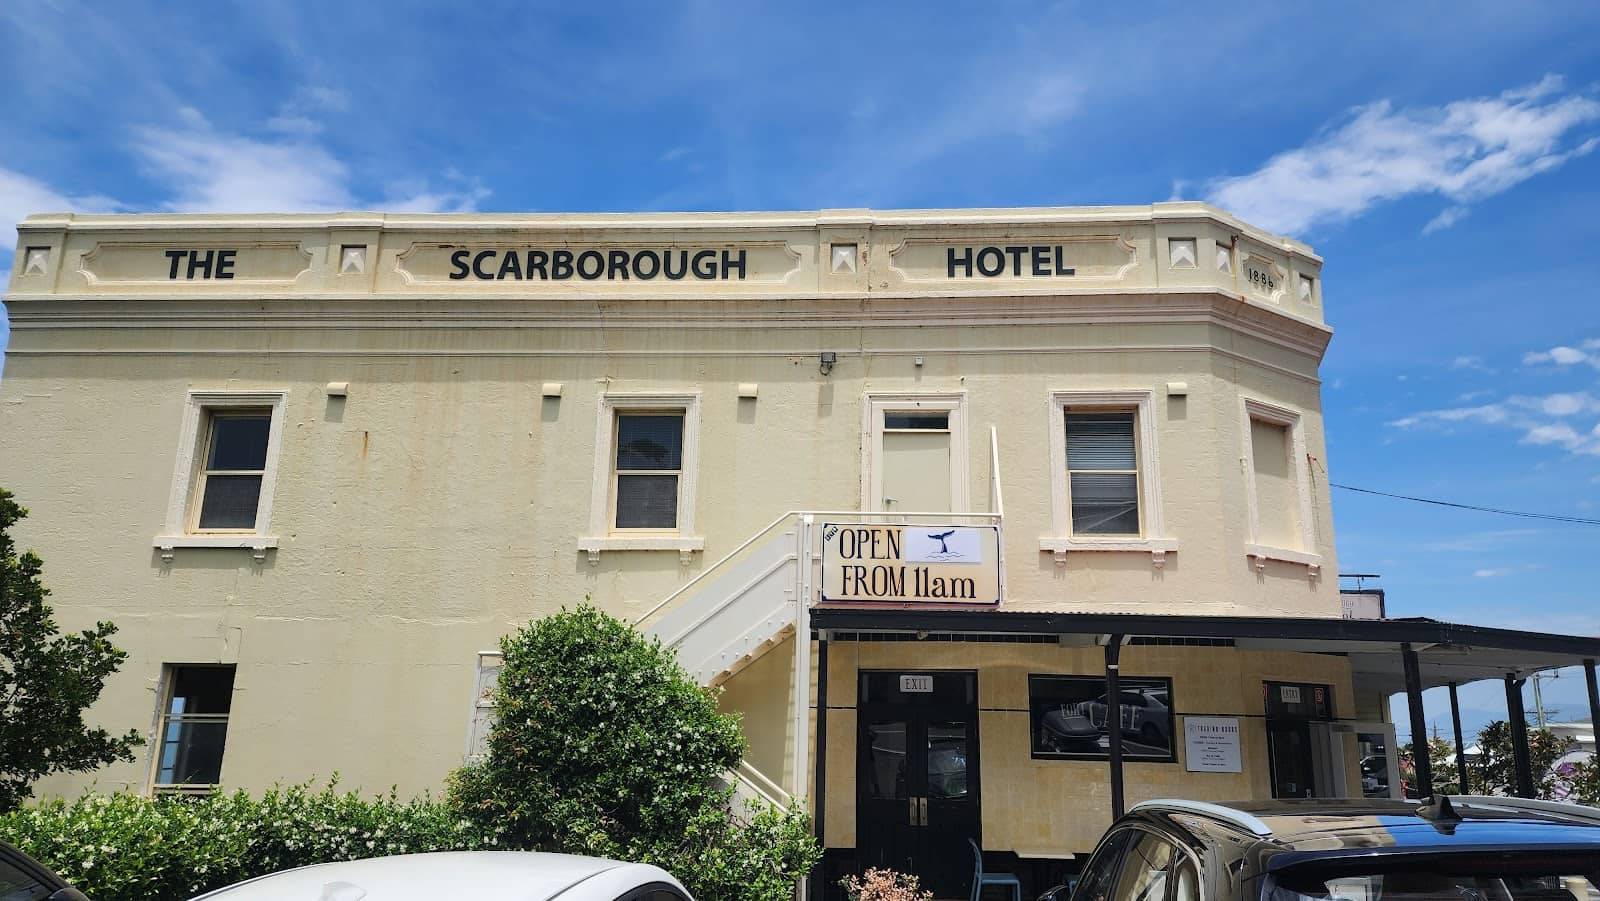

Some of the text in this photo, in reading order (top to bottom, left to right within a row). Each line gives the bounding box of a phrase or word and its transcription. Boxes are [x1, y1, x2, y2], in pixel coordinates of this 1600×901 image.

[165, 246, 1075, 281] THE SCARBOROUGH HOTEL
[1248, 267, 1274, 288] 1886
[839, 528, 902, 560] OPEN
[841, 565, 977, 599] FROM 11am
[905, 678, 928, 690] EXIT
